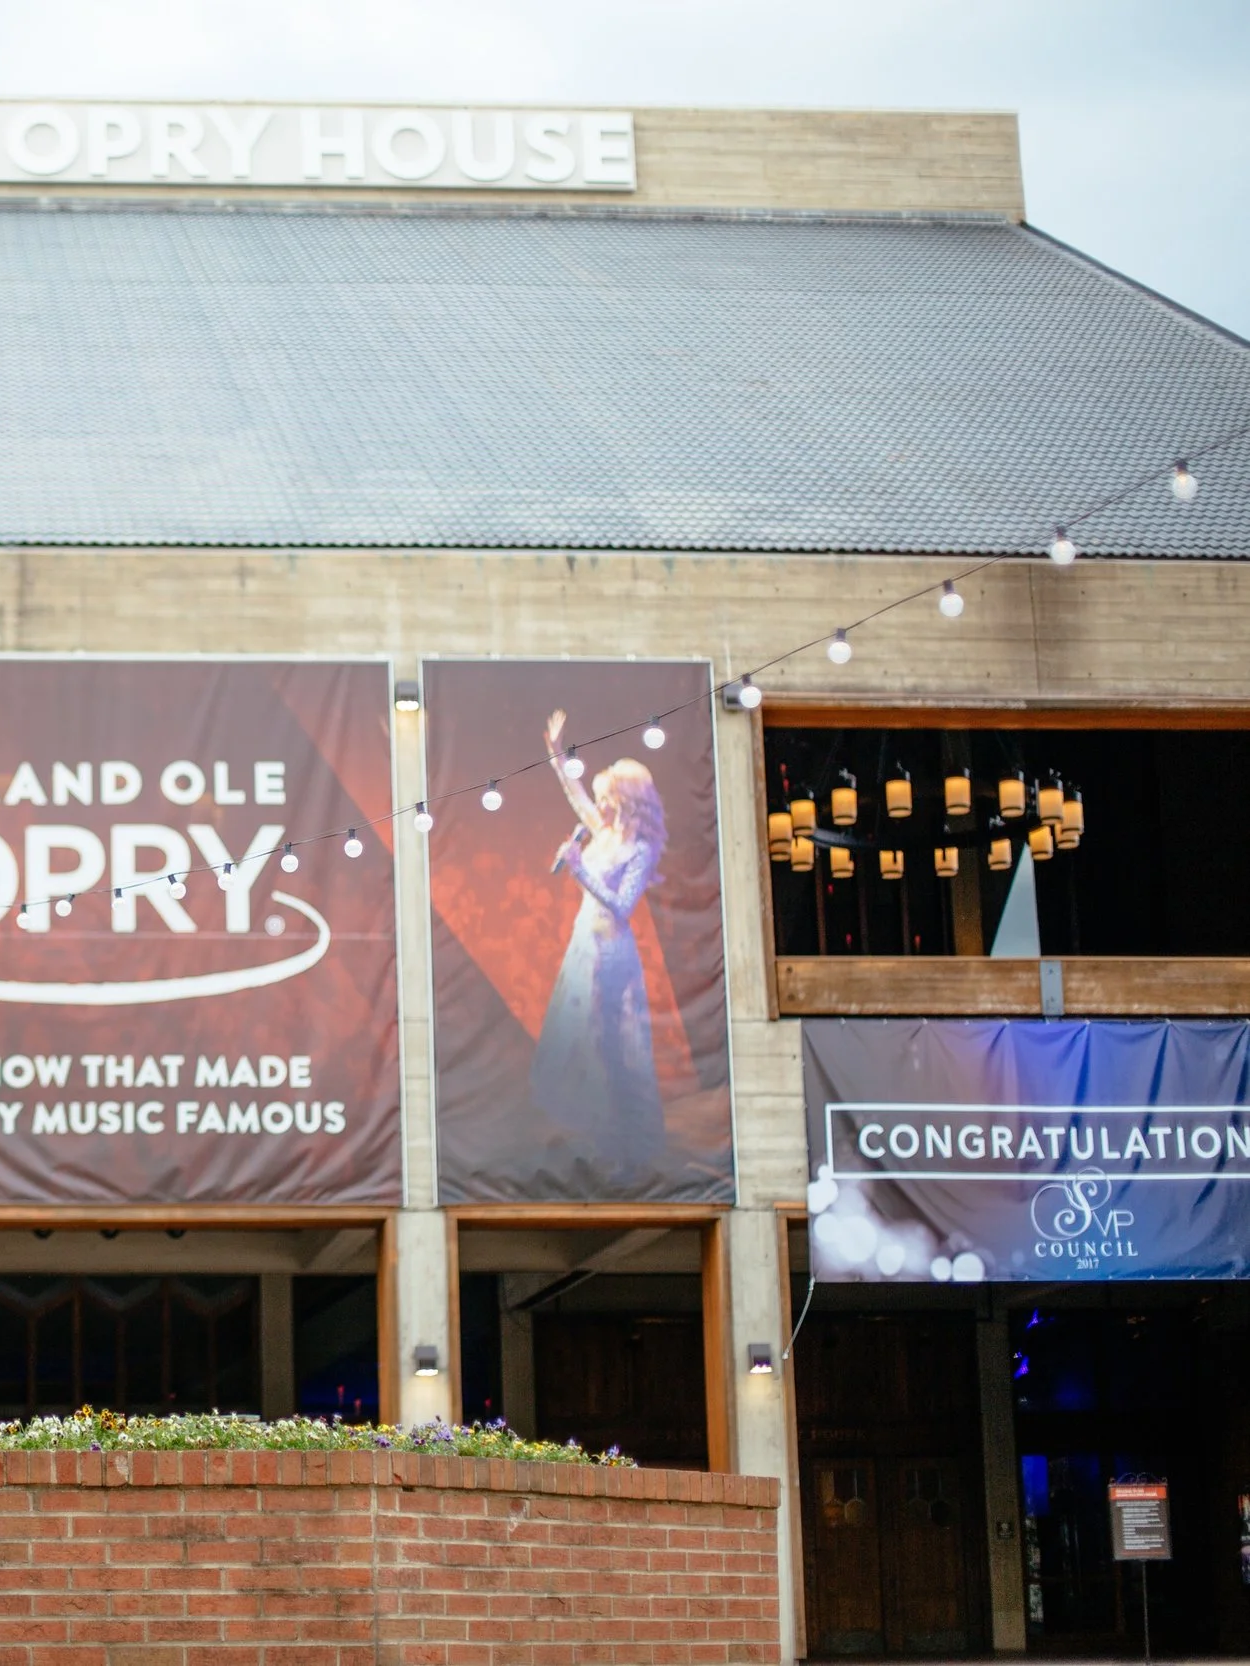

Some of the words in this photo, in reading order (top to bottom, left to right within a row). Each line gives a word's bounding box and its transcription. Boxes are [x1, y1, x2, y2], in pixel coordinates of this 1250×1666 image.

[5, 104, 274, 179] OPRY
[299, 108, 632, 184] HOUSE
[160, 760, 286, 805] OLE
[80, 1054, 184, 1088] THAT
[194, 1055, 312, 1088] MADE
[31, 1101, 165, 1135] MUSIC
[176, 1101, 347, 1135] FAMOUS
[1034, 1240, 1139, 1258] COUNCIL
[1076, 1257, 1100, 1270] 2017
